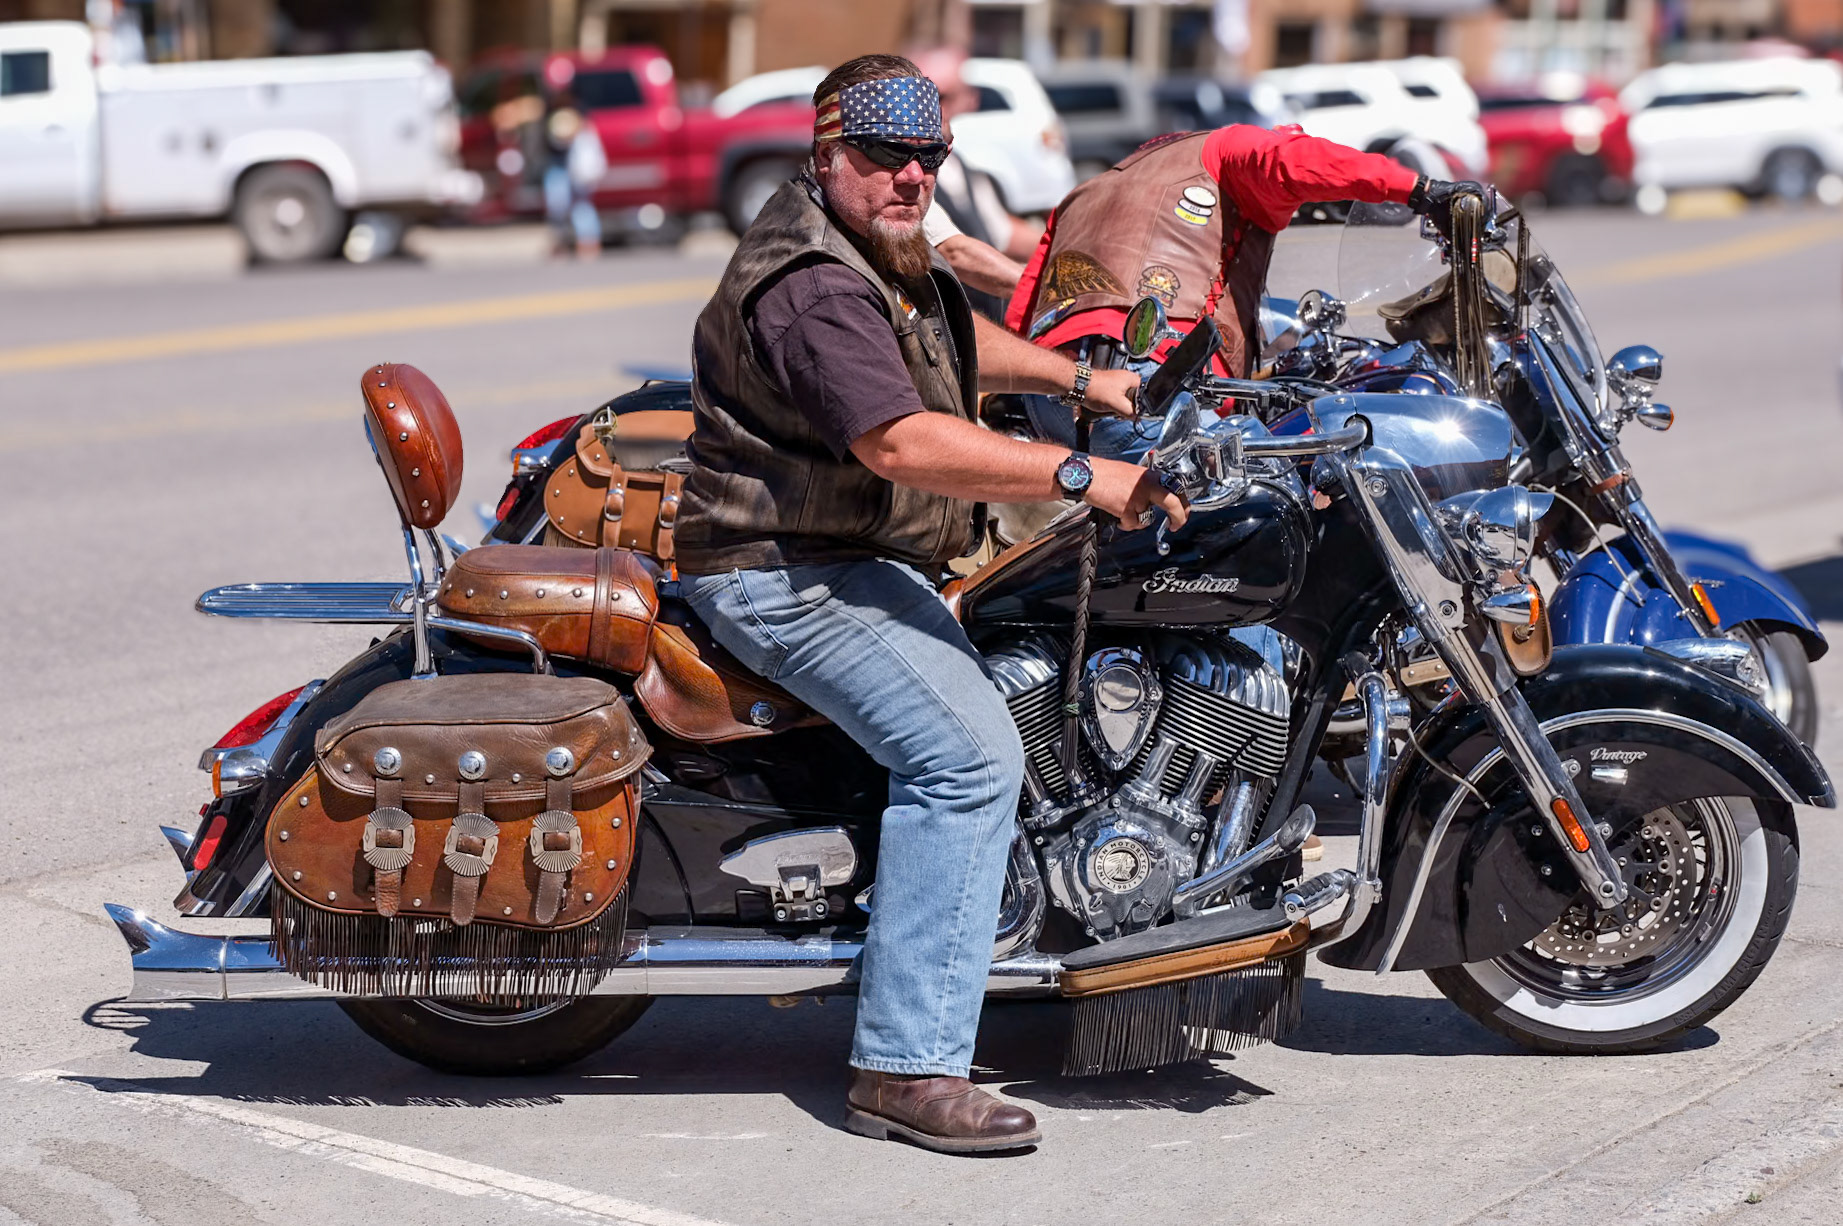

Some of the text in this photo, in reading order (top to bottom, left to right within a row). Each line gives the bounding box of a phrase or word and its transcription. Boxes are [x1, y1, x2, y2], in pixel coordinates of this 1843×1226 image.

[1142, 566, 1239, 593] Indian
[1590, 747, 1648, 764] Vintage
[1097, 841, 1147, 880] INDIAN MOTORCYCLE
